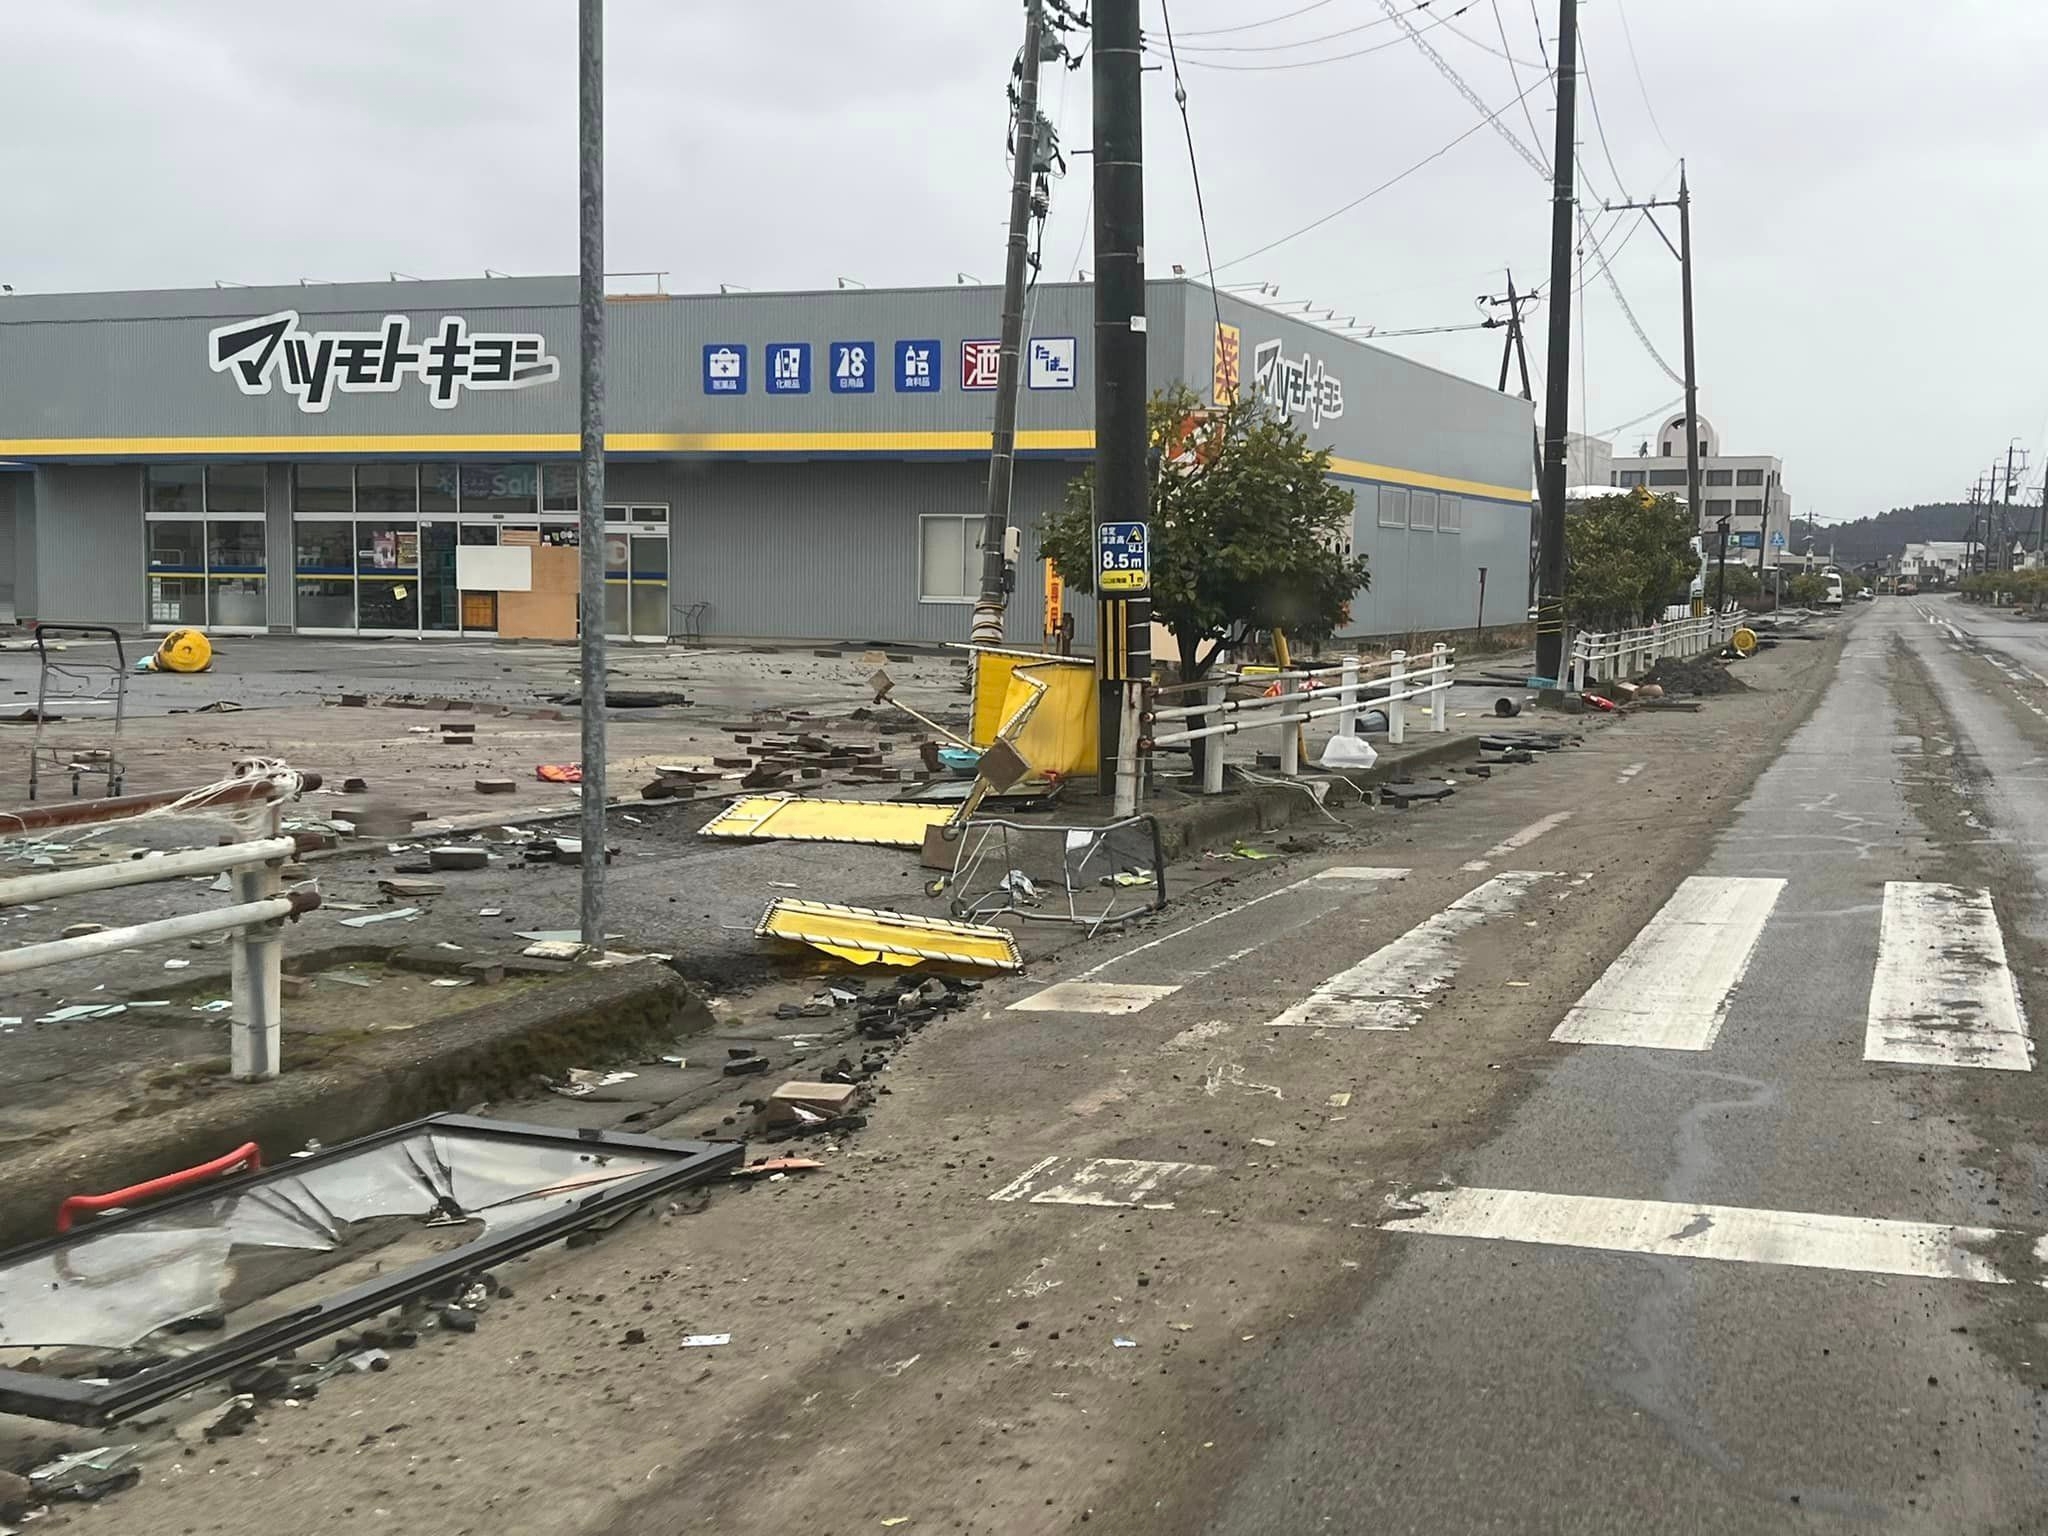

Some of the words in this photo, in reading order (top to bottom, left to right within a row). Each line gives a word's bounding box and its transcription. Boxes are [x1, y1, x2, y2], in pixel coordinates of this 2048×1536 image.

[212, 314, 557, 408] マツモトキヨシ
[1035, 345, 1069, 382] たばこ
[840, 378, 865, 388] 日用品
[905, 377, 930, 388] 食料品
